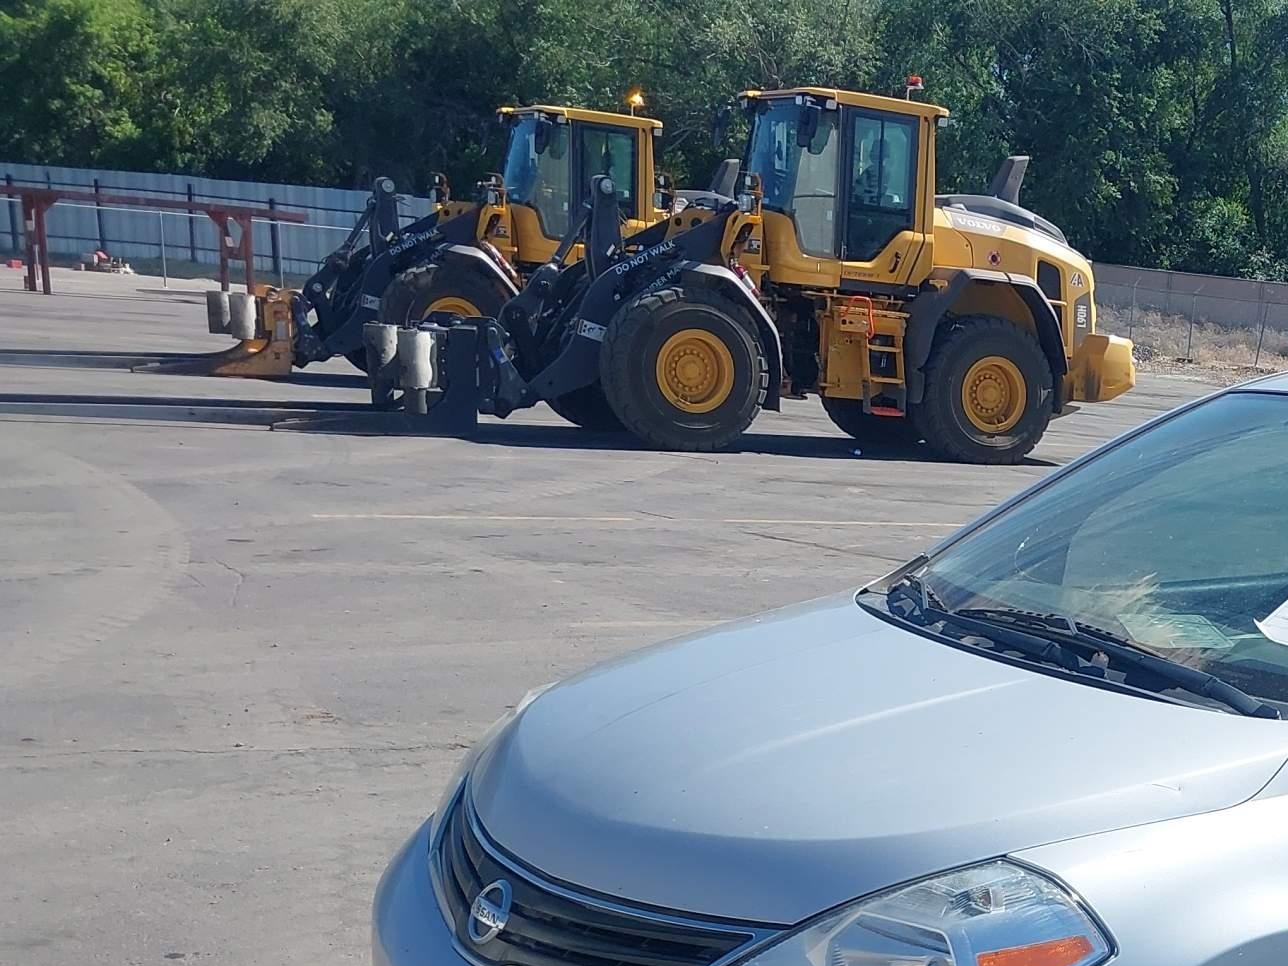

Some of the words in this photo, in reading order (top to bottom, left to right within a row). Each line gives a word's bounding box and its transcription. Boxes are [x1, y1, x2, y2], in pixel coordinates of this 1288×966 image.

[956, 217, 1001, 232] VOLVO
[390, 246, 402, 257] DO
[402, 239, 418, 252] NOT
[418, 228, 440, 242] WALK
[615, 263, 630, 275] DO
[630, 252, 649, 268] NOT
[649, 240, 676, 257] WALK
[1077, 305, 1087, 328] L90H
